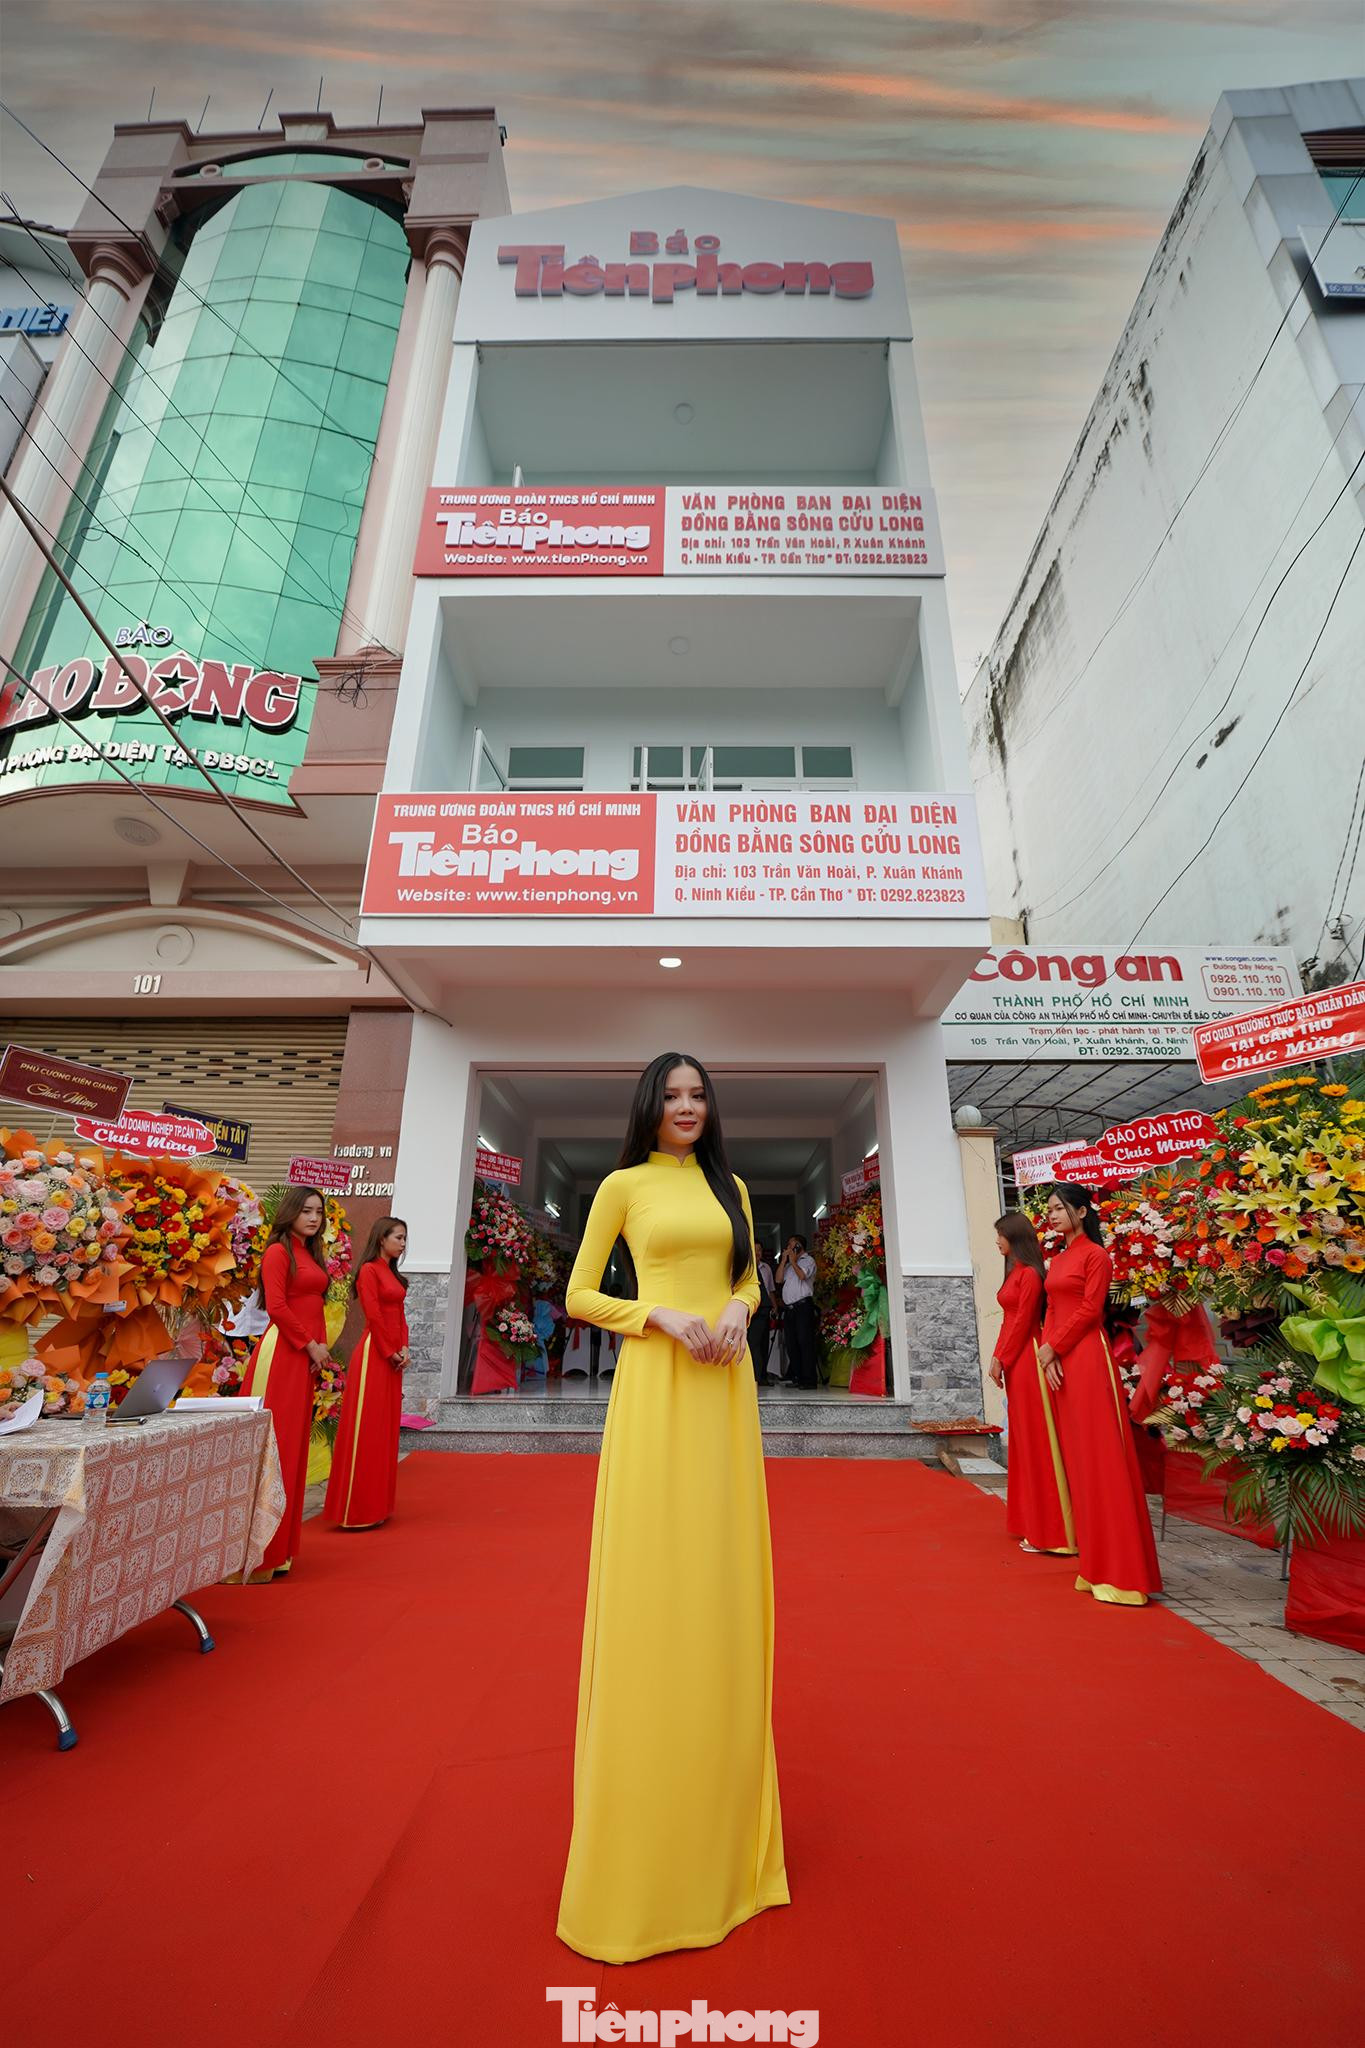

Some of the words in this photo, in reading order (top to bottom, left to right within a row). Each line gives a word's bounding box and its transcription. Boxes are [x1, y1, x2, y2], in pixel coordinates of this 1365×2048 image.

[629, 229, 721, 255] Báo
[440, 494, 477, 505] TRUNG
[479, 493, 511, 505] ƯƠNG
[514, 492, 546, 505] ĐOÀN
[549, 494, 579, 505] TNCS
[600, 492, 620, 505] CHÍ
[622, 494, 655, 505] MINH
[682, 492, 716, 510] VĂN
[728, 492, 785, 510] PHÒNG
[797, 496, 831, 510] BAN
[842, 496, 871, 513] ĐẠI
[882, 493, 922, 512] DIỆN
[500, 508, 548, 525] Báo
[681, 512, 728, 531] ĐỒNG
[734, 510, 780, 531] BẰNG
[787, 513, 833, 531] SÔNG
[839, 511, 873, 531] CỬU
[879, 516, 924, 531] LONG
[731, 538, 750, 548] 103
[854, 537, 884, 548] Xuân
[889, 537, 925, 548] Khánh
[444, 553, 507, 565] Website:
[696, 553, 721, 564] Ninh
[89, 651, 303, 729] ĐỘNG
[5, 746, 65, 772] PHÒNG
[67, 742, 101, 765] ĐẠI
[103, 740, 156, 765] DIỆN
[393, 805, 436, 816] TRUNG
[440, 803, 476, 816] ƯƠNG
[479, 802, 516, 816] ĐOÀN
[519, 804, 554, 816] TNCS
[557, 800, 576, 816] HỒ
[580, 801, 602, 816] CHÍ
[605, 804, 641, 816] MINH
[676, 799, 716, 822] VĂN
[729, 799, 797, 822] PHÒNG
[810, 804, 851, 822] BAN
[864, 804, 897, 827] ĐẠI
[910, 801, 957, 828] DIỆN
[462, 824, 518, 844] Báo
[675, 827, 731, 853] ĐỒNG
[737, 826, 793, 853] BẰNG
[799, 830, 854, 853] SÔNG
[861, 827, 901, 854] CỬU
[907, 835, 961, 855] LONG
[675, 865, 696, 880] Địa
[702, 863, 727, 878] chỉ:
[733, 866, 757, 878] 103
[762, 862, 791, 878] Trần
[797, 865, 821, 878] Văn
[827, 865, 861, 880] Hoài,
[866, 866, 877, 879] P.
[883, 866, 916, 879] Xuân
[922, 866, 963, 880] Khánh
[397, 889, 471, 902] Website:
[476, 888, 639, 904] www.tienphong.vn
[674, 888, 687, 902] Q.
[691, 887, 722, 901] Ninh
[726, 885, 755, 901] Kiều
[769, 888, 787, 901] TP.
[791, 885, 816, 901] Cần
[819, 887, 843, 901] Thơ
[857, 888, 876, 902] ĐT:
[880, 888, 966, 902] 0292.823823
[132, 974, 162, 995] 101
[993, 993, 1044, 1007] THÀNH
[1052, 993, 1083, 1007] PHỐ
[1092, 993, 1113, 1007] HỒ
[1121, 994, 1146, 1007] CHÍ
[1153, 996, 1189, 1007] MINH
[970, 1012, 992, 1020] QUAN
[1012, 1011, 1036, 1020] CÔNG
[1052, 1011, 1078, 1020] THÀNH
[1080, 1010, 1096, 1020] PHỐ
[1112, 1011, 1126, 1020] CHÍ
[1212, 1027, 1236, 1042] QUAN
[1295, 1001, 1315, 1018] BÁO
[1316, 994, 1345, 1014] NHÂN
[1099, 1026, 1118, 1037] phát
[1122, 1026, 1145, 1035] hành
[1164, 1027, 1179, 1035] TP.
[1086, 1037, 1111, 1045] Xuân
[1166, 1037, 1189, 1045] Ninh
[1229, 1038, 1255, 1054] TẠI
[1079, 1047, 1099, 1056] ĐT:
[1221, 1049, 1278, 1071] Chúc
[1285, 1031, 1355, 1058] Mừng
[127, 1118, 150, 1133] DOANH
[93, 1128, 141, 1146] Chúc
[1105, 1128, 1136, 1145] BÁO
[1114, 1145, 1153, 1161] Chúc
[1066, 1170, 1099, 1182] Chúc
[355, 1183, 393, 1196] 823020
